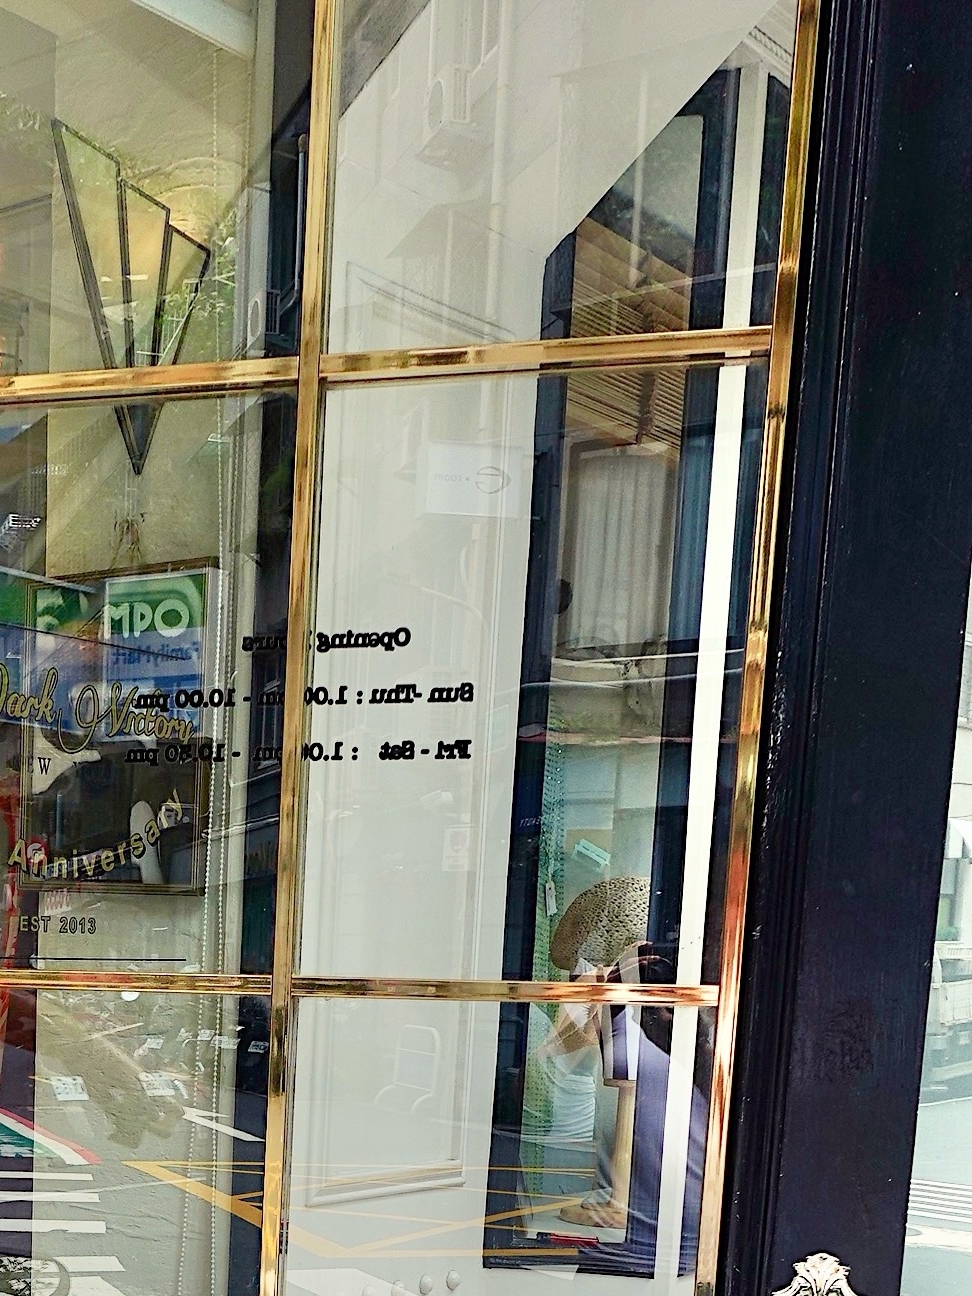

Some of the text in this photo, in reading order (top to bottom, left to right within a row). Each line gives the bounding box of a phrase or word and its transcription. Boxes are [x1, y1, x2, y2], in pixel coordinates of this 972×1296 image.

[58, 681, 195, 754] Victory
[7, 788, 183, 880] Anniversary
[19, 915, 96, 934] EST 2013
